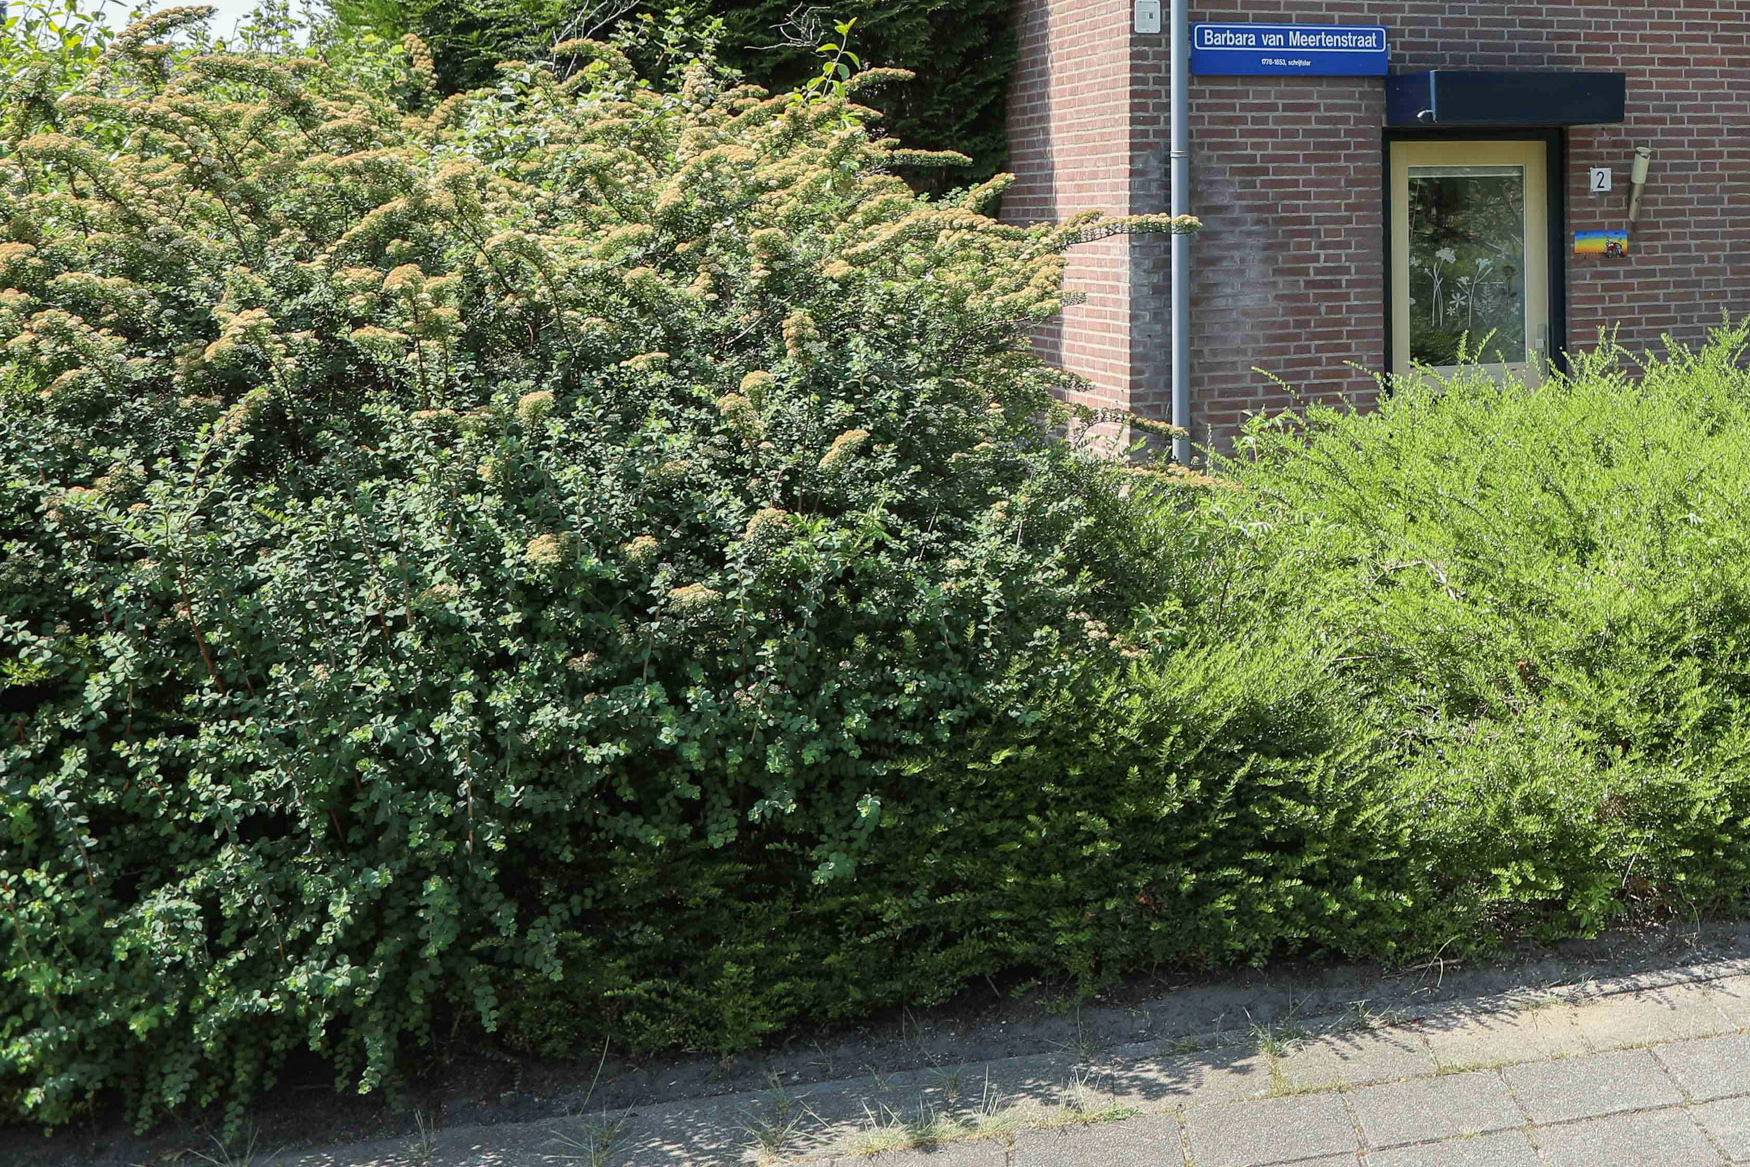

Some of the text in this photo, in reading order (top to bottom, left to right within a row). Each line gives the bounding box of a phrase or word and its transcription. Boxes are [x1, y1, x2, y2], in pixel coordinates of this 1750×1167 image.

[1204, 29, 1377, 48] Barbara van Meertenstraat
[1596, 171, 1605, 189] 2
